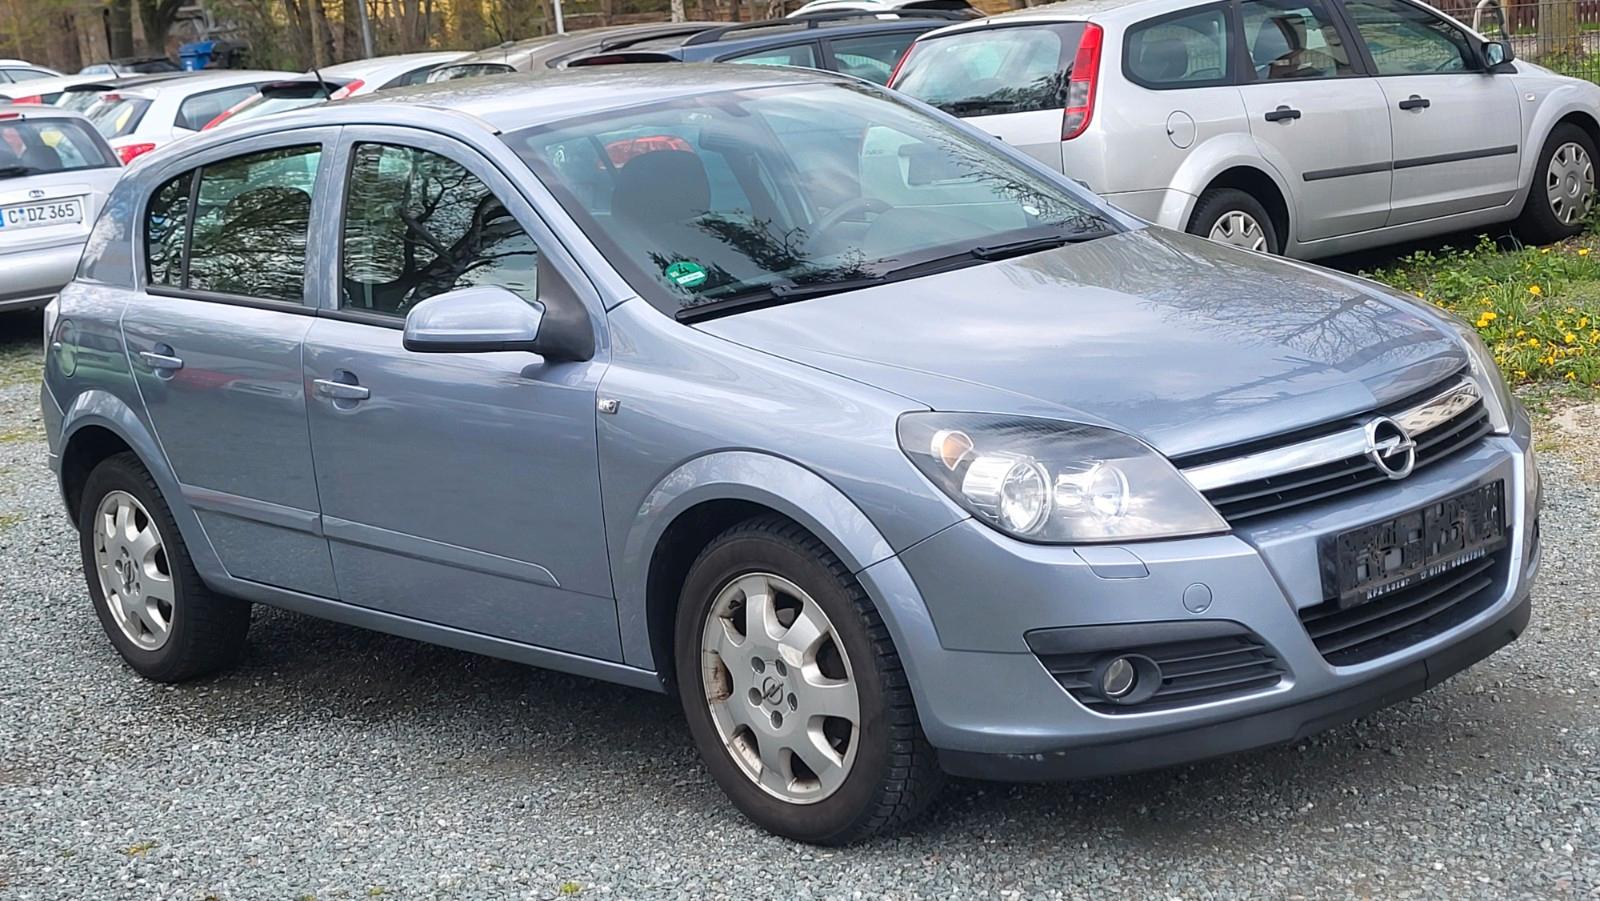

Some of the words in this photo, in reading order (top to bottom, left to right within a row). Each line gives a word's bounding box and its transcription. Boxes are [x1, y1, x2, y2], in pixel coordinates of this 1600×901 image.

[8, 211, 18, 223] C
[27, 207, 46, 221] DZ
[49, 204, 74, 218] 365
